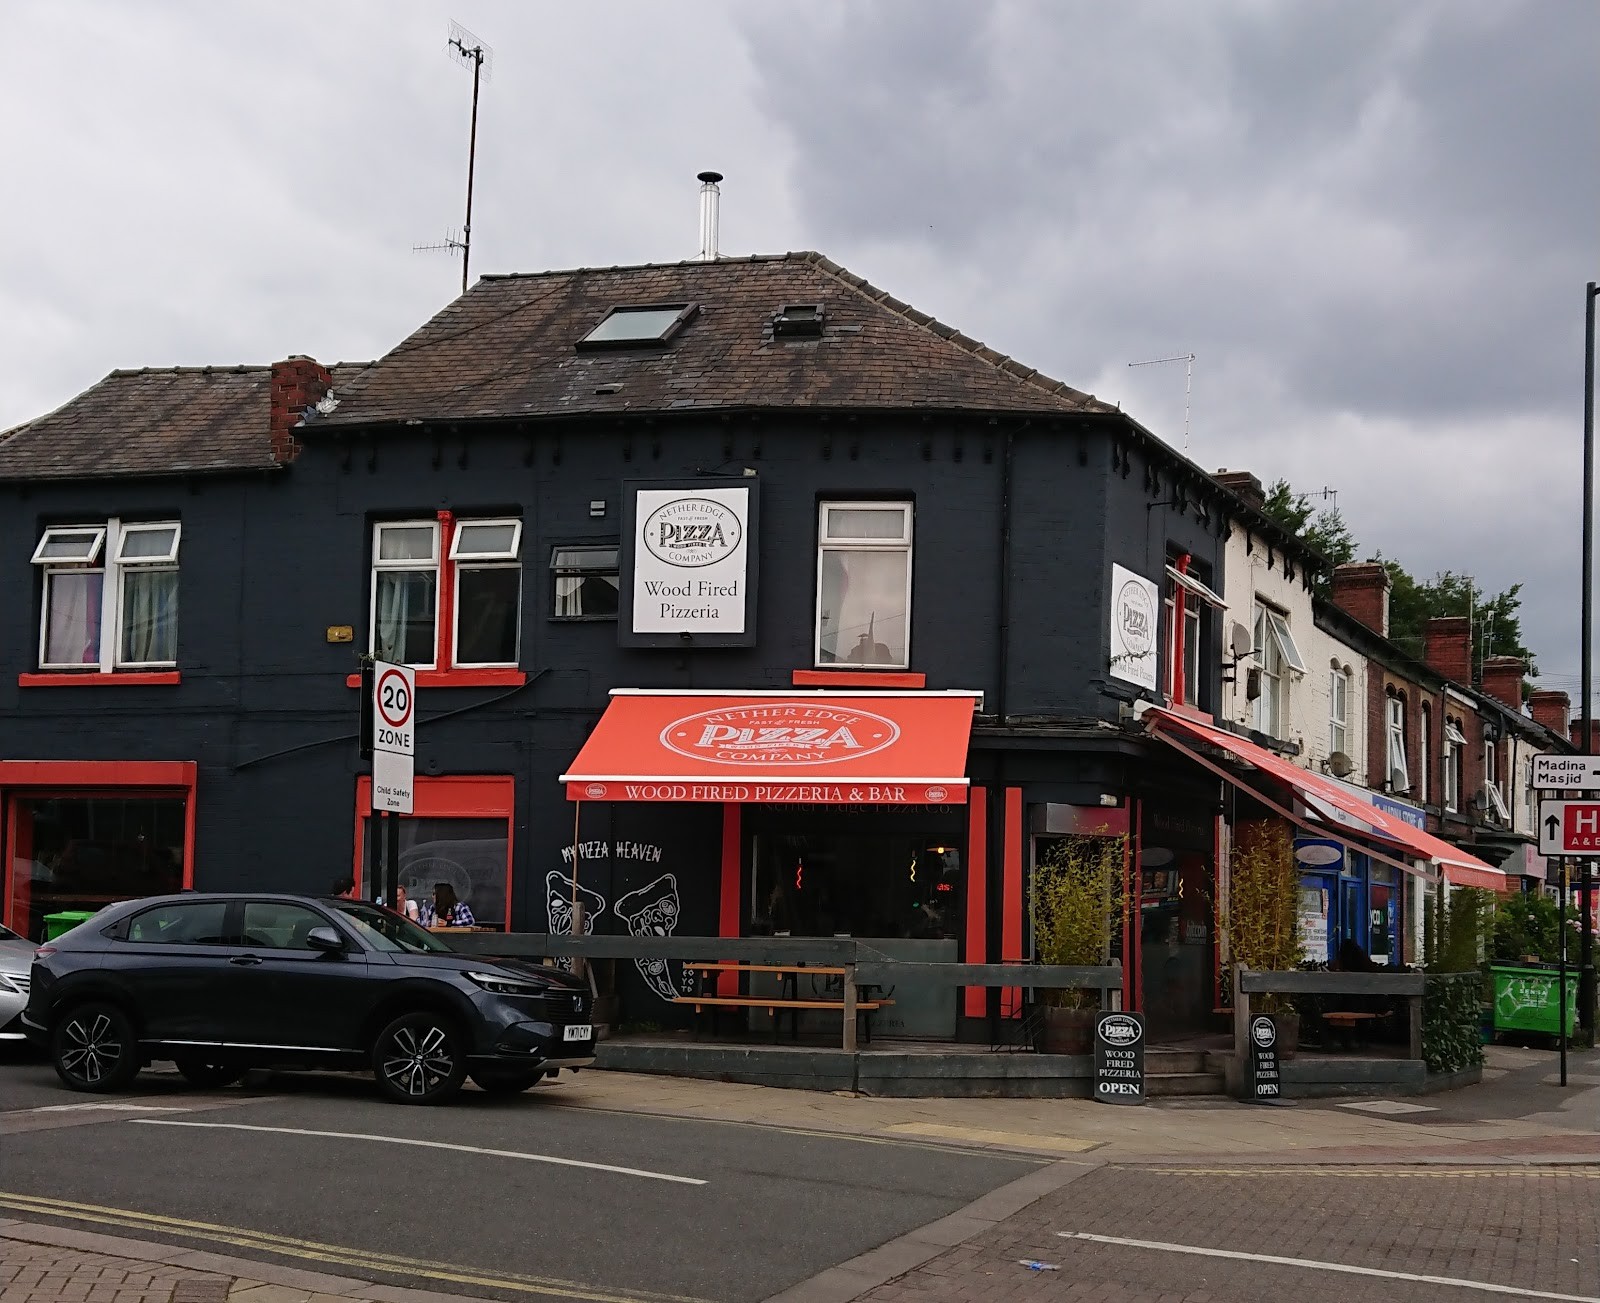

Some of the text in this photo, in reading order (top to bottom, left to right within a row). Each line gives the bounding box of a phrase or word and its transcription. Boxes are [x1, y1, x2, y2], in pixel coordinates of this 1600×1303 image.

[660, 504, 725, 520] NETHER EDGE
[659, 522, 728, 547] PIZZA
[668, 551, 713, 562] COMPANY
[644, 580, 738, 596] Wood Fired
[660, 603, 719, 618] Pizzeria
[1124, 602, 1150, 640] PIZZA
[384, 686, 407, 711] 20
[705, 708, 860, 725] NETHER EDGE
[379, 729, 410, 748] ZONE
[694, 724, 864, 749] PIZZA
[716, 751, 825, 761] COMPANY
[1538, 760, 1586, 770] Madina
[1538, 774, 1582, 785] Masjid
[377, 786, 410, 798] Child Safety
[625, 786, 906, 801] WOOD FIRED PIZZERIA & BAR
[387, 798, 400, 807] Zone
[1576, 810, 1598, 834] H
[1572, 837, 1600, 846] A & E
[578, 841, 608, 859] PIZZA
[616, 841, 662, 862] HEAVEN
[1105, 1024, 1136, 1038] PIZZA
[1105, 1050, 1135, 1059] WOOD
[1258, 1052, 1274, 1060] WOOD
[1106, 1060, 1134, 1068] FIRED
[1099, 1069, 1141, 1078] PIZZERIA
[1100, 1082, 1140, 1094] OPEN
[1257, 1084, 1278, 1094] OPEN
